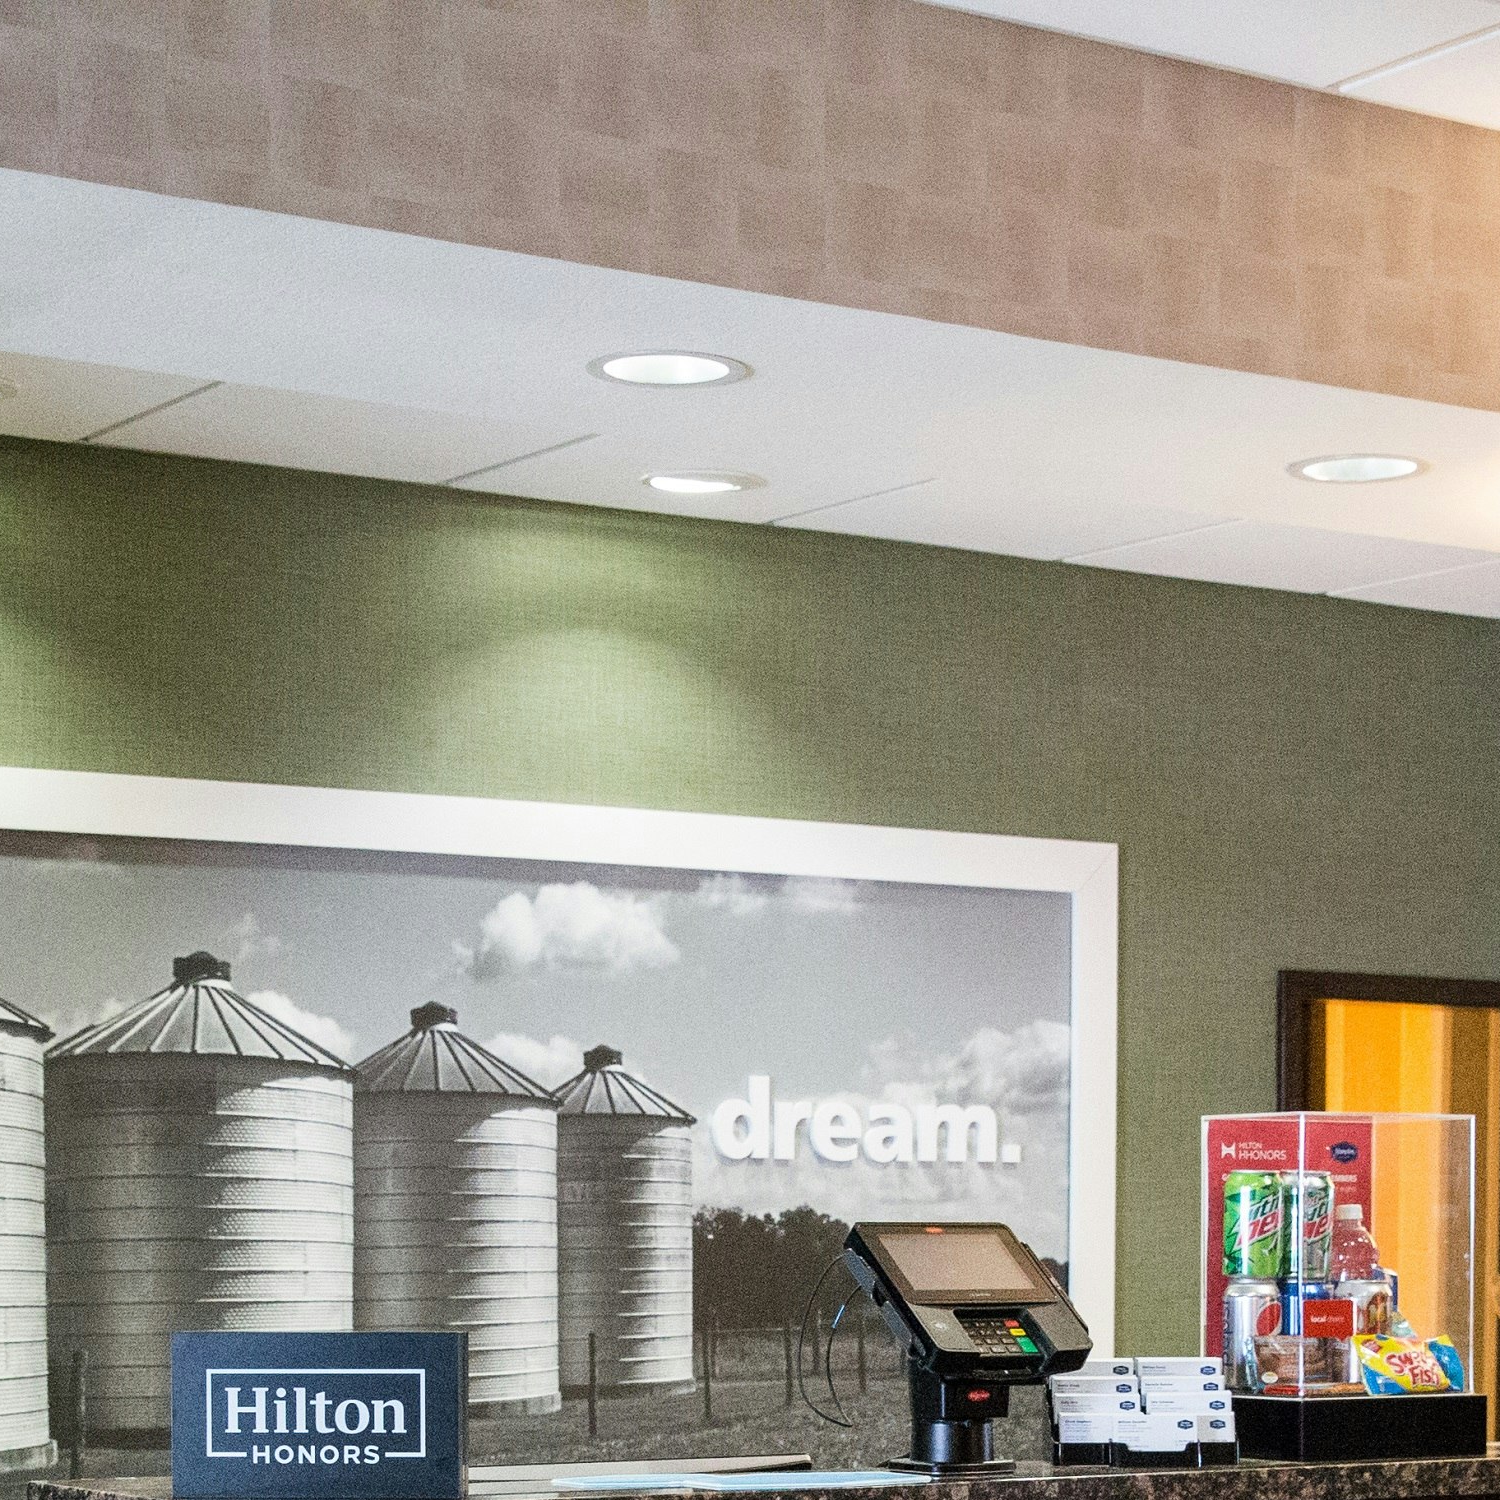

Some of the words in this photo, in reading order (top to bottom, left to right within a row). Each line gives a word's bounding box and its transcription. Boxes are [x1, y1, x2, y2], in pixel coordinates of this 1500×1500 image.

[711, 1075, 1021, 1164] dream.
[1238, 1150, 1287, 1160] HHONORS
[224, 1387, 407, 1434] Hilton
[252, 1445, 380, 1465] HONORS
